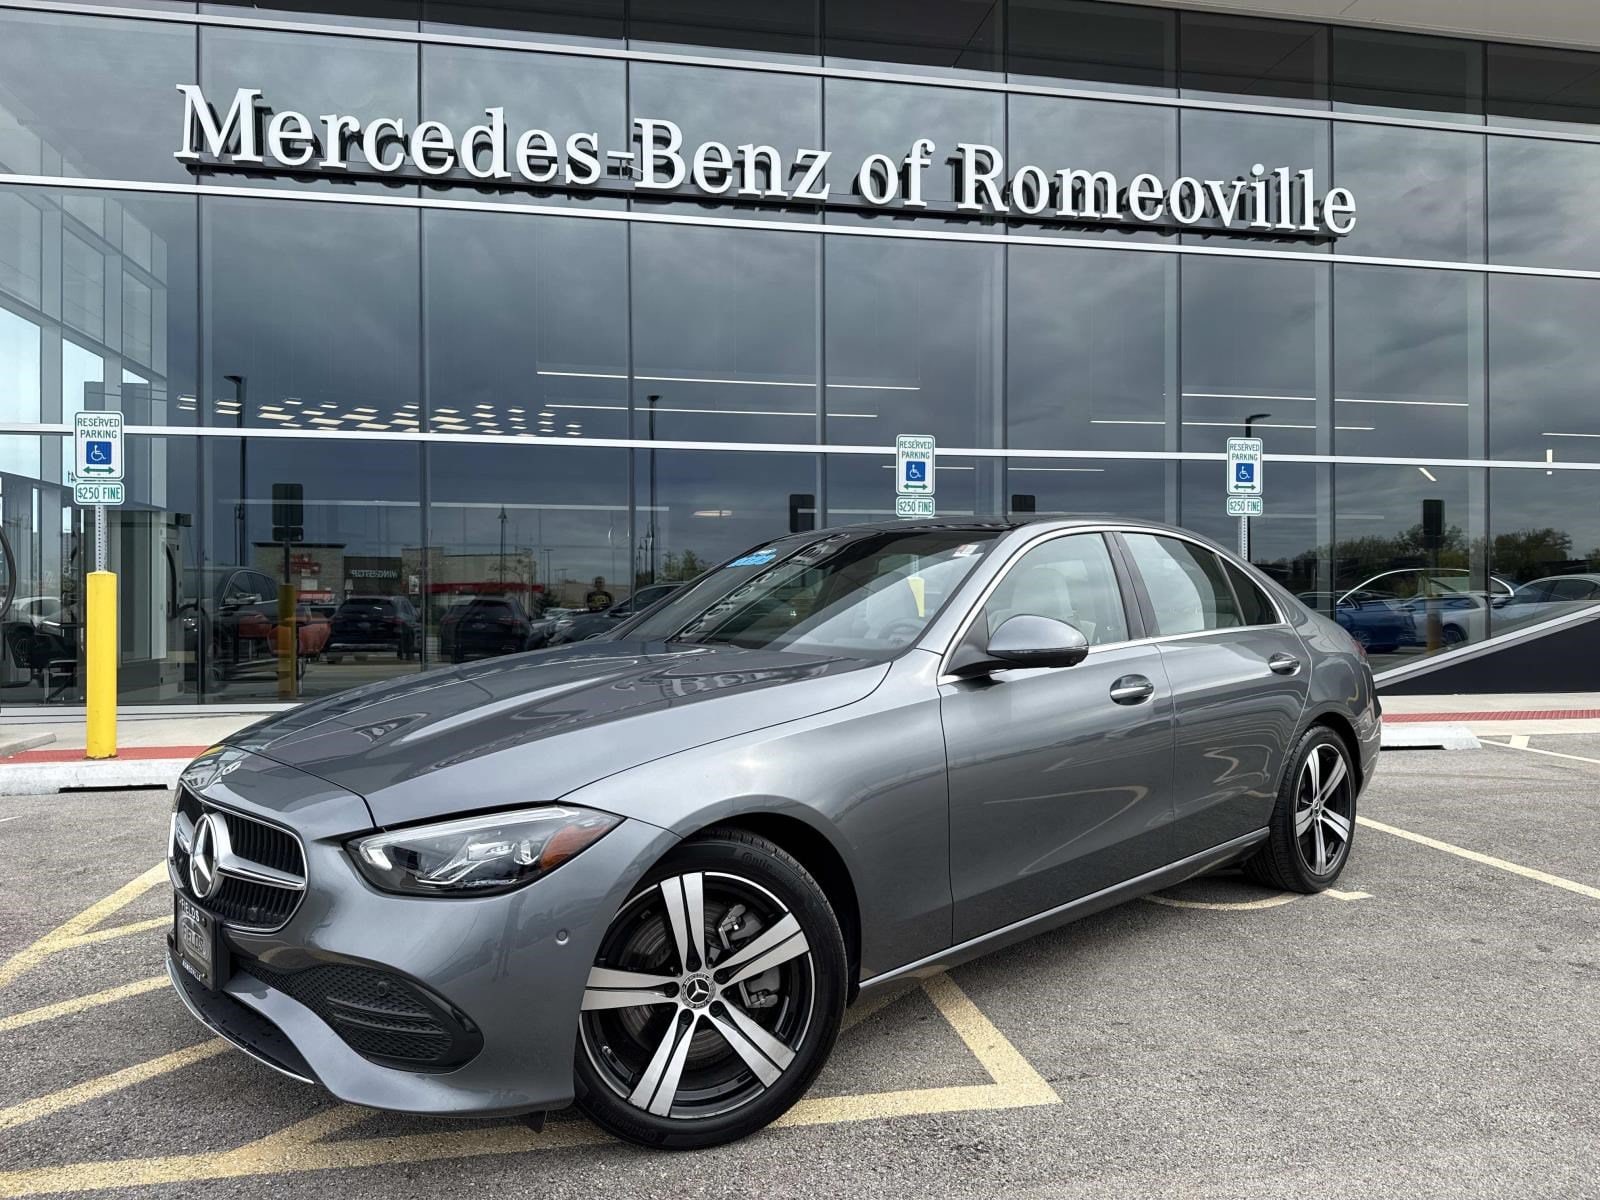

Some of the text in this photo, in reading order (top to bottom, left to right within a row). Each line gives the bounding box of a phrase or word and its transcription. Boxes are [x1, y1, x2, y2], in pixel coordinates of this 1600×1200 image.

[173, 83, 1357, 235] Mercedes-Benz of Romeoville
[77, 417, 120, 428] RESERVED
[80, 429, 117, 439] PARKING
[900, 440, 932, 449] RESERVED
[1229, 443, 1260, 452] RESERVED
[902, 451, 929, 459] PARKING
[1232, 453, 1257, 461] PARKING
[78, 487, 121, 500] $250 FINE
[899, 500, 932, 512] $250 FINE
[1229, 501, 1260, 512] $250 FINE
